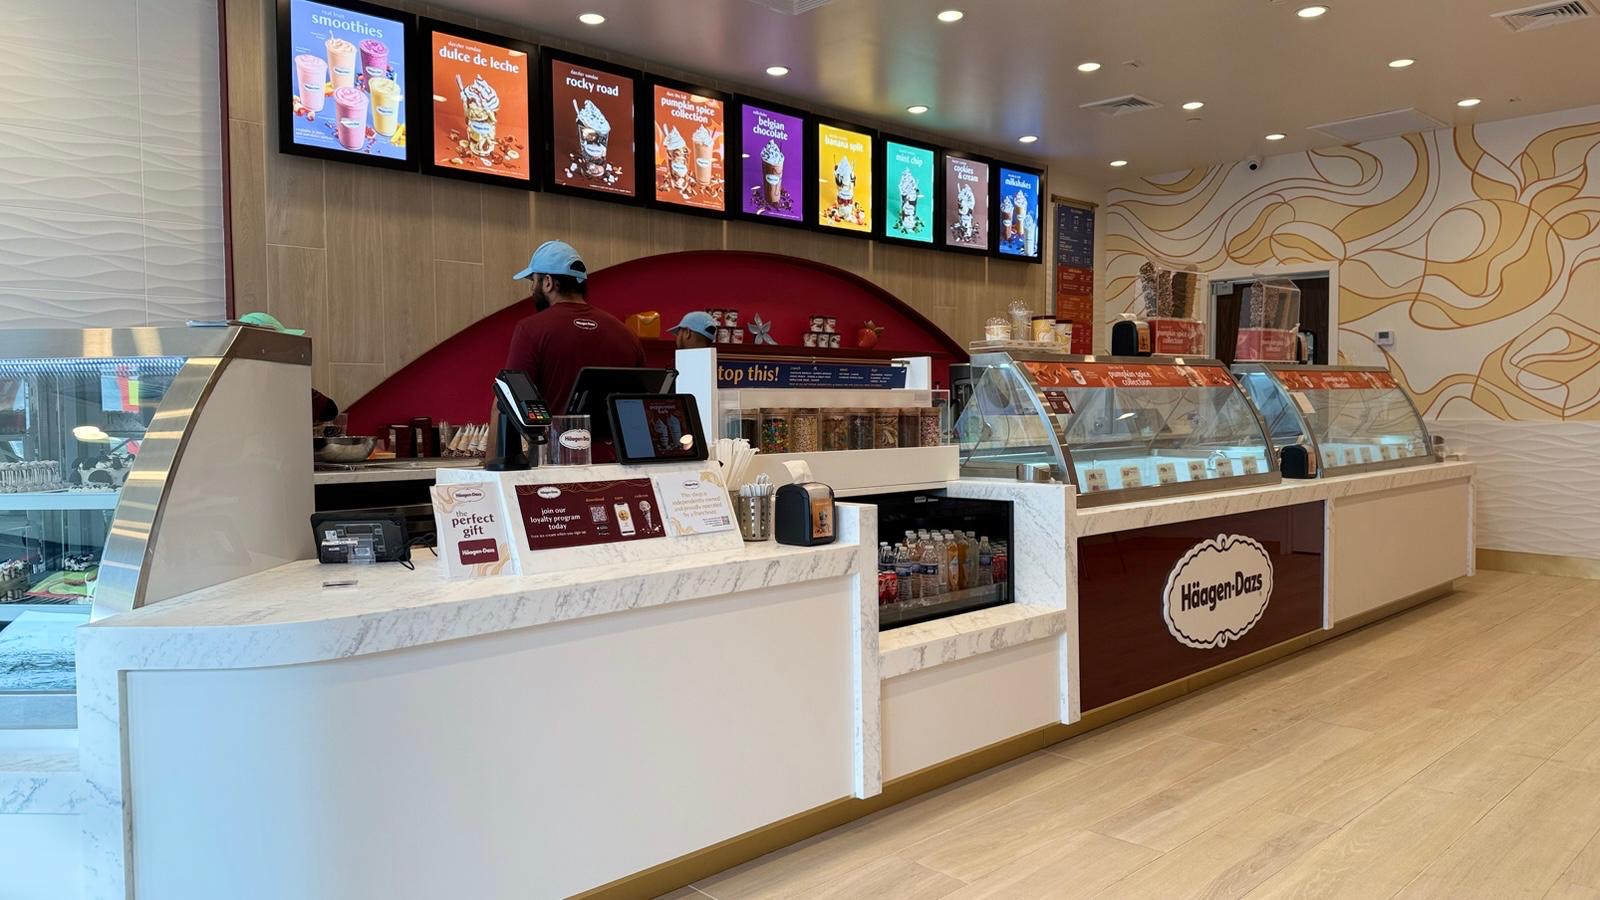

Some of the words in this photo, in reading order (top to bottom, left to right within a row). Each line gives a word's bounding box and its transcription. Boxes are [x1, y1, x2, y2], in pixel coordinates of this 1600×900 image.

[311, 13, 384, 39] smoothies
[439, 46, 471, 63] dulce
[473, 54, 488, 67] de
[490, 56, 520, 74] leche
[566, 77, 595, 93] rocky
[596, 84, 619, 97] road
[661, 97, 695, 111] pumpkin
[695, 105, 716, 117] spice
[671, 108, 709, 124] collection
[758, 115, 785, 131] belgian
[752, 124, 789, 141] chocolate
[825, 134, 849, 149] banana
[850, 143, 864, 153] split
[896, 153, 910, 164] mint
[910, 155, 924, 168] chip
[953, 164, 974, 175] cookies
[963, 174, 979, 183] cream
[1004, 178, 1032, 190] milkshakes
[718, 365, 744, 384] top
[748, 364, 780, 383] this!
[1108, 369, 1137, 379] pumpkin
[1135, 370, 1152, 379] spice
[1121, 378, 1153, 386] collection
[541, 507, 555, 515] join
[452, 513, 495, 528] perfect
[530, 516, 553, 524] loyalty
[553, 514, 581, 523] program
[462, 525, 484, 538] gift
[461, 547, 495, 556] Häagen-Dazs
[1181, 571, 1263, 612] Häagen-Dazs
